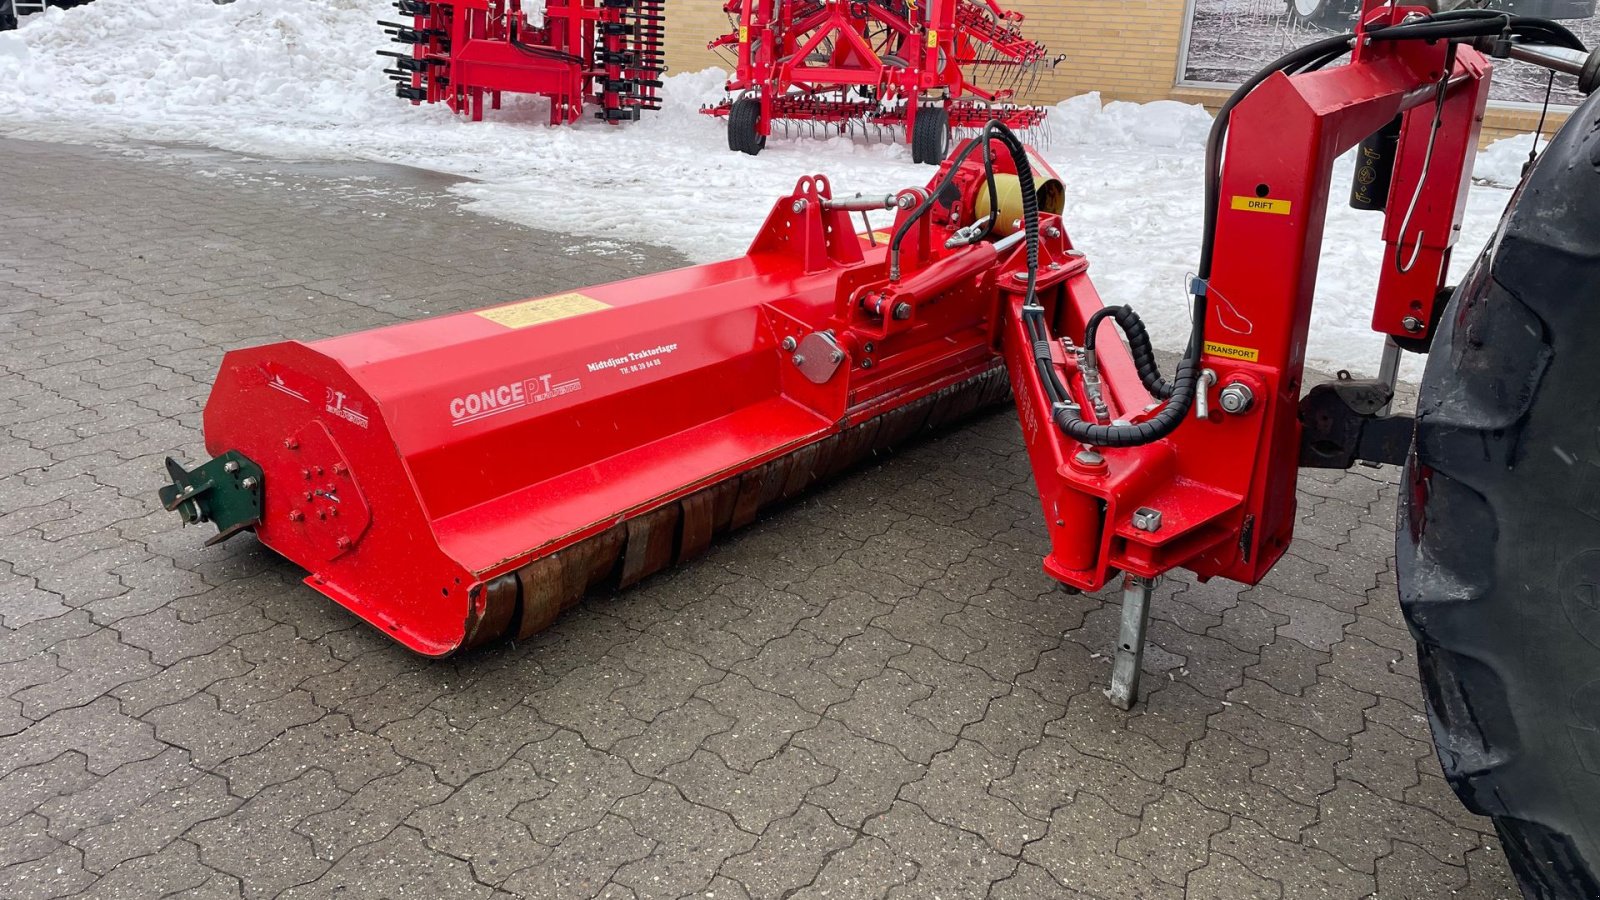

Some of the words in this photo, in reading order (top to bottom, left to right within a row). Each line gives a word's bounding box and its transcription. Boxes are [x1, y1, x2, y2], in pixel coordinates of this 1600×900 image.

[1248, 200, 1273, 209] DRIFT
[586, 355, 629, 373] Midtdjurs
[628, 343, 678, 361] Traktorlager
[1207, 344, 1255, 358] TRANSPORT
[450, 374, 552, 419] CONCEPT
